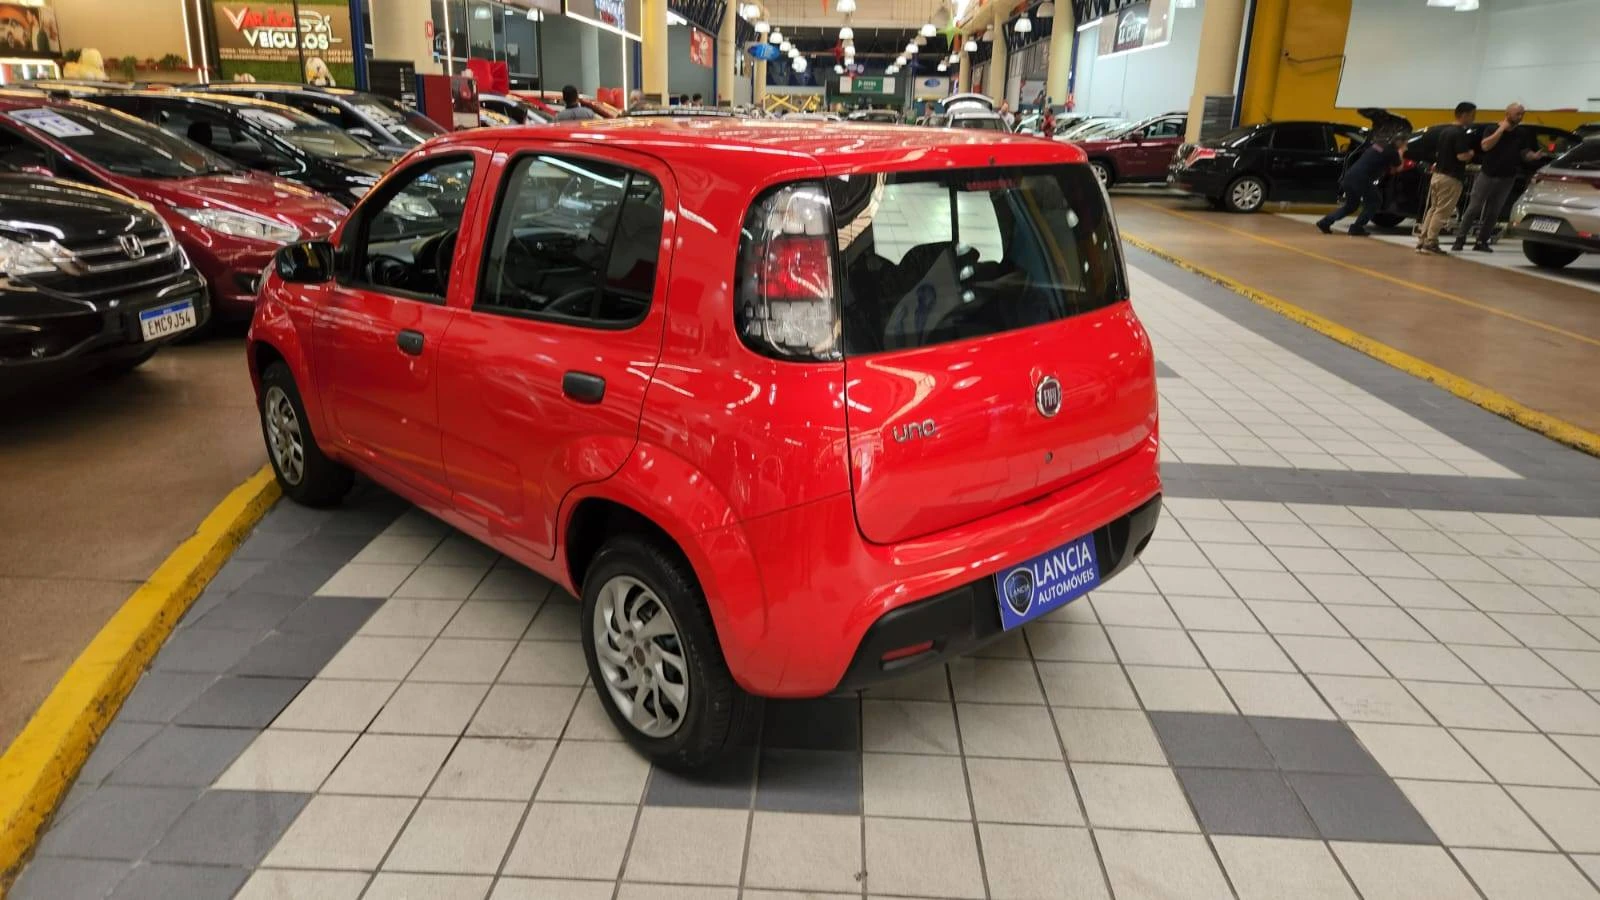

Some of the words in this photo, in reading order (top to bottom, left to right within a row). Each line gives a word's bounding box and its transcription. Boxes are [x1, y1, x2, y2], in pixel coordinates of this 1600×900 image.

[147, 311, 191, 335] EMC9J54
[1034, 542, 1092, 587] LANCIA
[1039, 568, 1095, 605] AUTOMÓVEIS
